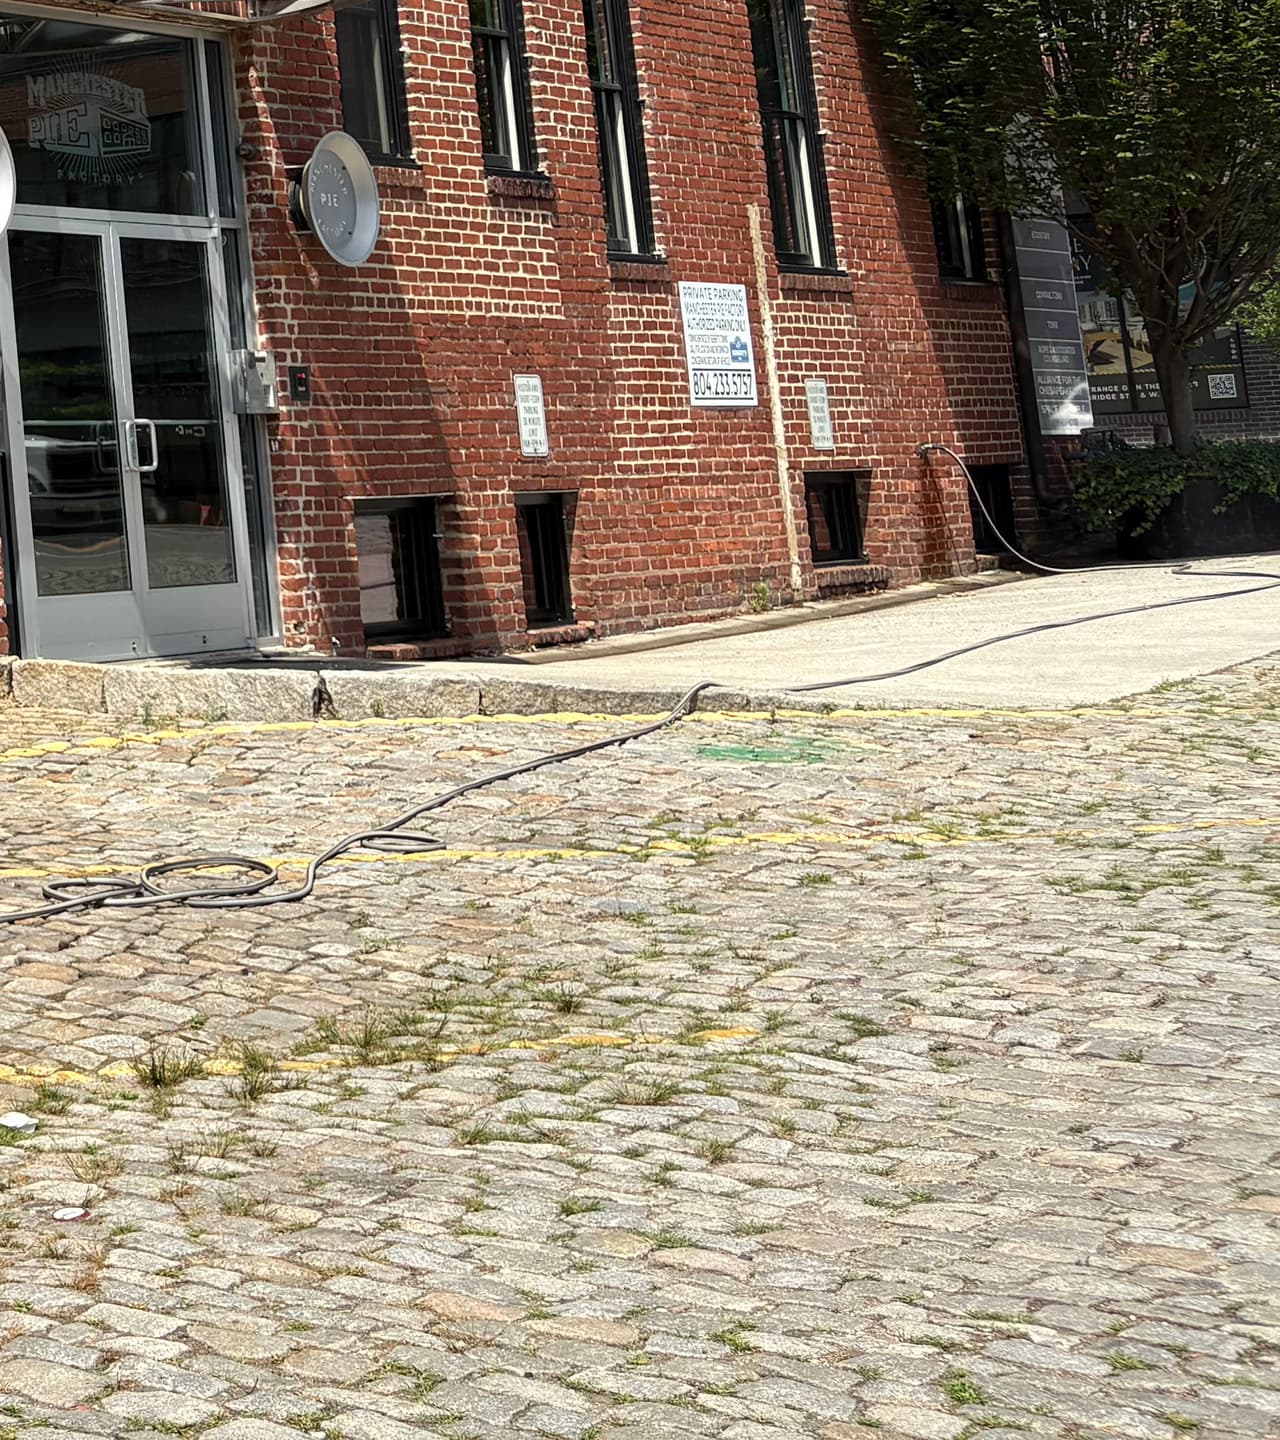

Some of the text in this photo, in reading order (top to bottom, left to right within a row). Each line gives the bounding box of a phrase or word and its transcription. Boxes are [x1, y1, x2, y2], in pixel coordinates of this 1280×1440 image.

[28, 101, 90, 149] PIE
[57, 169, 134, 184] FACTORY
[320, 192, 338, 208] PIE
[683, 286, 743, 302] PRIVATE PARKING
[693, 372, 752, 395] 804.233.5757
[1089, 392, 1116, 400] RIDGE
